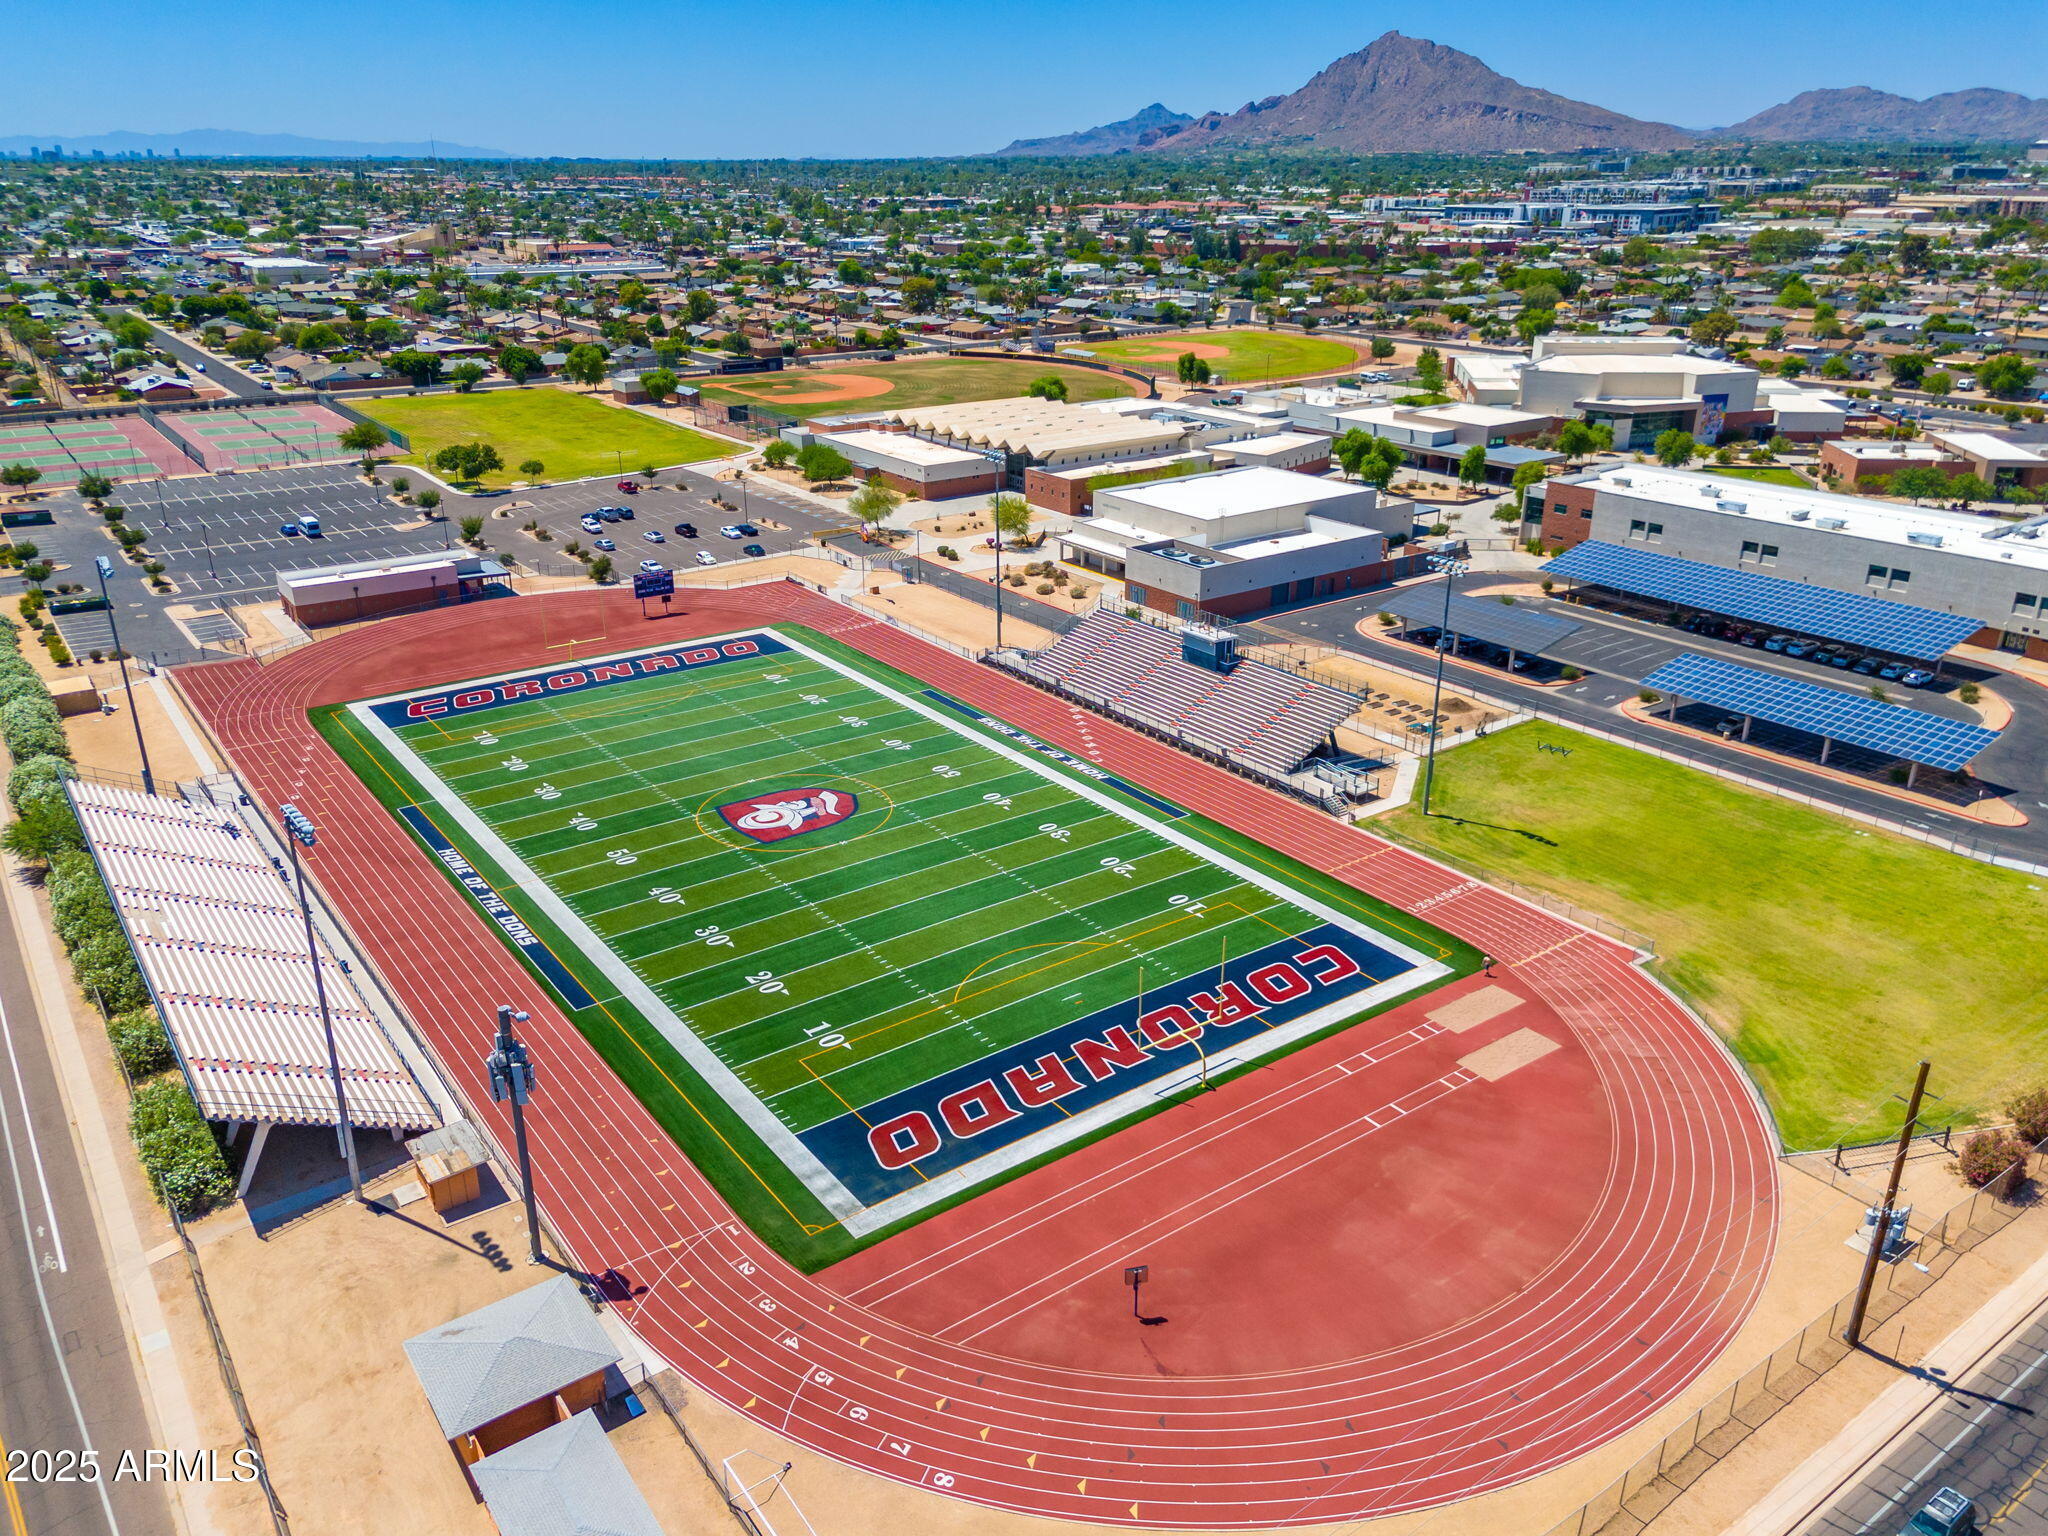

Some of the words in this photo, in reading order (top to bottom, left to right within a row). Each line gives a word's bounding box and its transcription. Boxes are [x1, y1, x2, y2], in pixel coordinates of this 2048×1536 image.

[406, 640, 759, 718] CORONADO
[766, 674, 791, 684] 10
[842, 716, 869, 727] 30
[977, 717, 1016, 735] DONS
[473, 733, 499, 745] 10
[885, 739, 912, 751] 40
[1013, 734, 1044, 749] THE
[1041, 749, 1066, 759] OF
[501, 757, 529, 772] 20
[932, 765, 961, 778] 50
[1063, 759, 1109, 780] HOME
[534, 786, 562, 800] 30
[982, 792, 1012, 806] 40
[569, 817, 598, 831] 40
[1038, 823, 1071, 839] 30
[606, 848, 637, 865] 50
[1100, 857, 1136, 874] 20
[438, 847, 474, 875] HOME
[464, 876, 489, 889] OF
[478, 891, 509, 914] THE
[498, 914, 539, 946] DONS
[648, 887, 681, 904] 40
[1168, 894, 1208, 915] 10
[695, 925, 730, 946] 30
[745, 970, 784, 994] 20
[803, 1020, 845, 1048] 10
[867, 944, 1361, 1171] CORONADO
[726, 1224, 741, 1236] 1
[739, 1261, 756, 1276] 2
[759, 1299, 776, 1312] 3
[782, 1336, 800, 1350] 4
[814, 1371, 834, 1386] 5
[849, 1406, 869, 1421] 6
[890, 1442, 912, 1457] 7
[933, 1472, 955, 1488] 8
